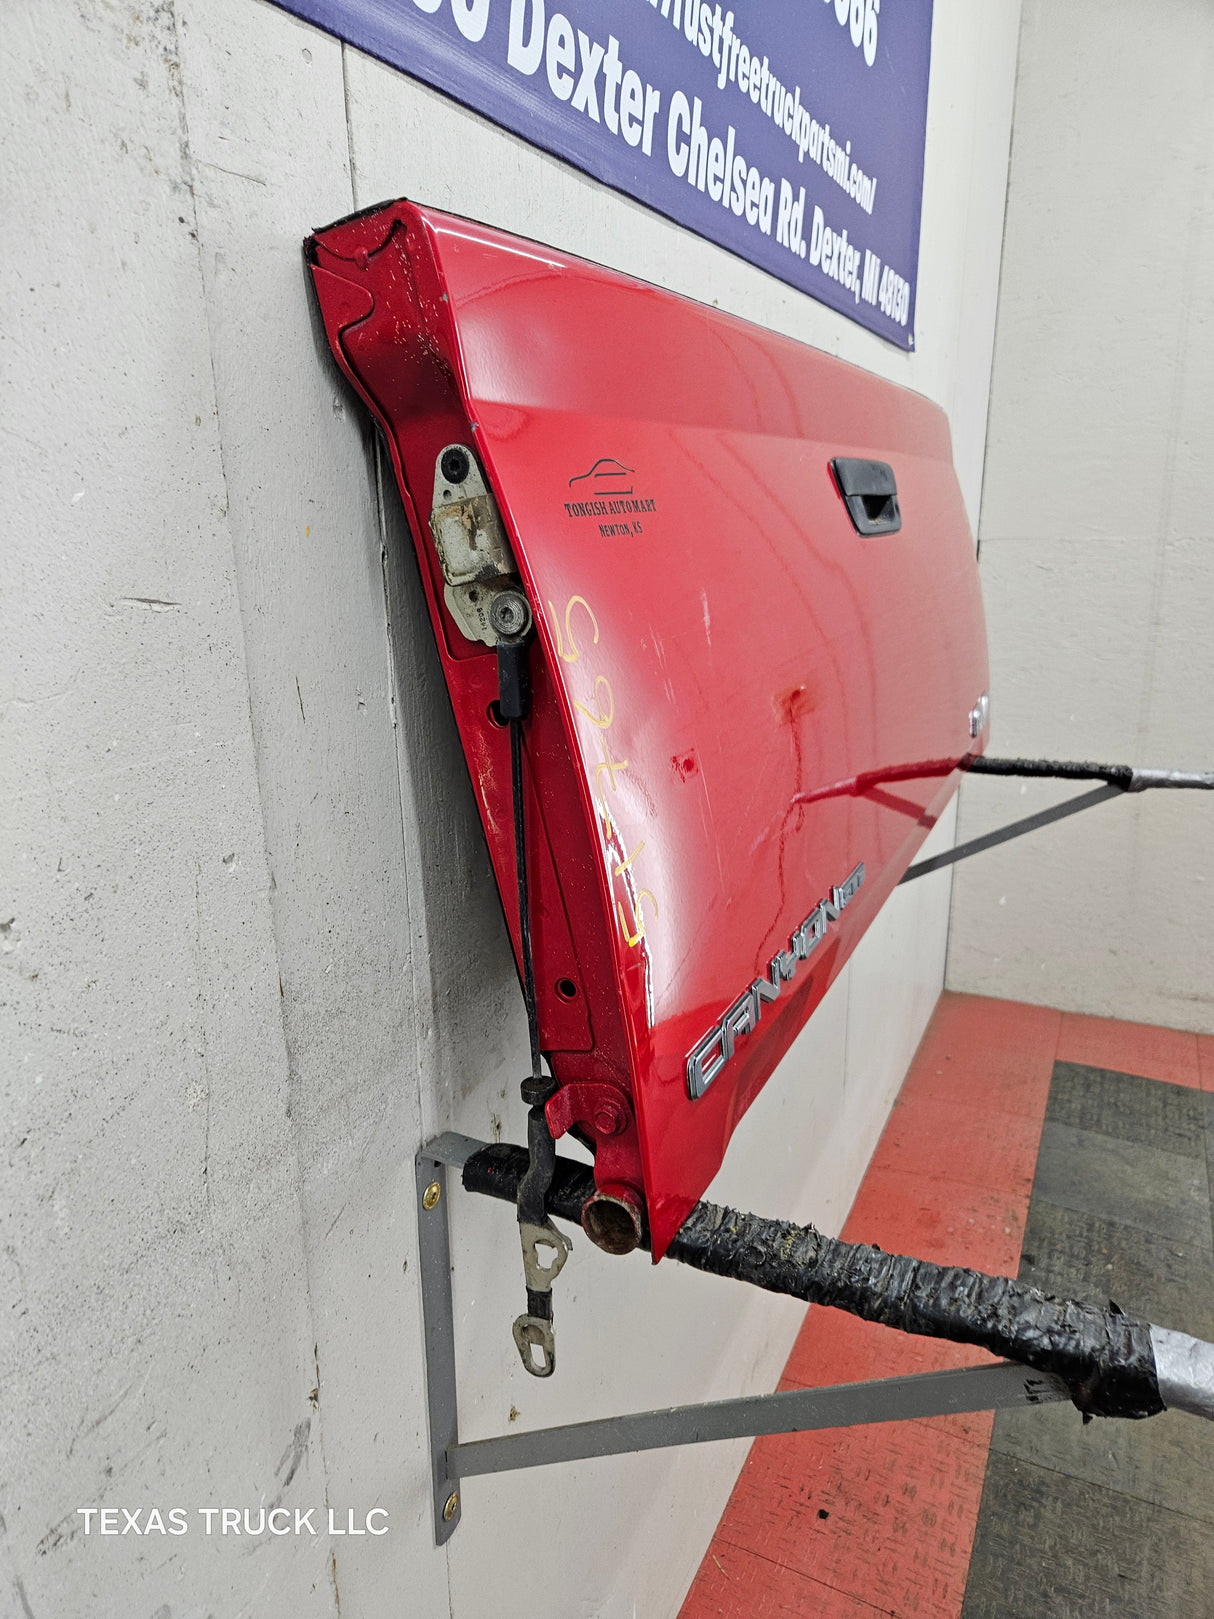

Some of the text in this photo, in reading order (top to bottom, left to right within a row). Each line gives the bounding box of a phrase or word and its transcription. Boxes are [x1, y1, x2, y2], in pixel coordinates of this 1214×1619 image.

[507, 0, 660, 157] Dexter
[666, 90, 776, 236] Chelsea
[776, 177, 807, 260] Rd.
[809, 205, 861, 304] Dexter,
[862, 249, 881, 306] MI
[878, 265, 911, 327] 48130
[564, 498, 657, 518] TONGISH AUTO MART
[598, 520, 643, 538] NEWTON, KS
[686, 884, 841, 1101] CANYON
